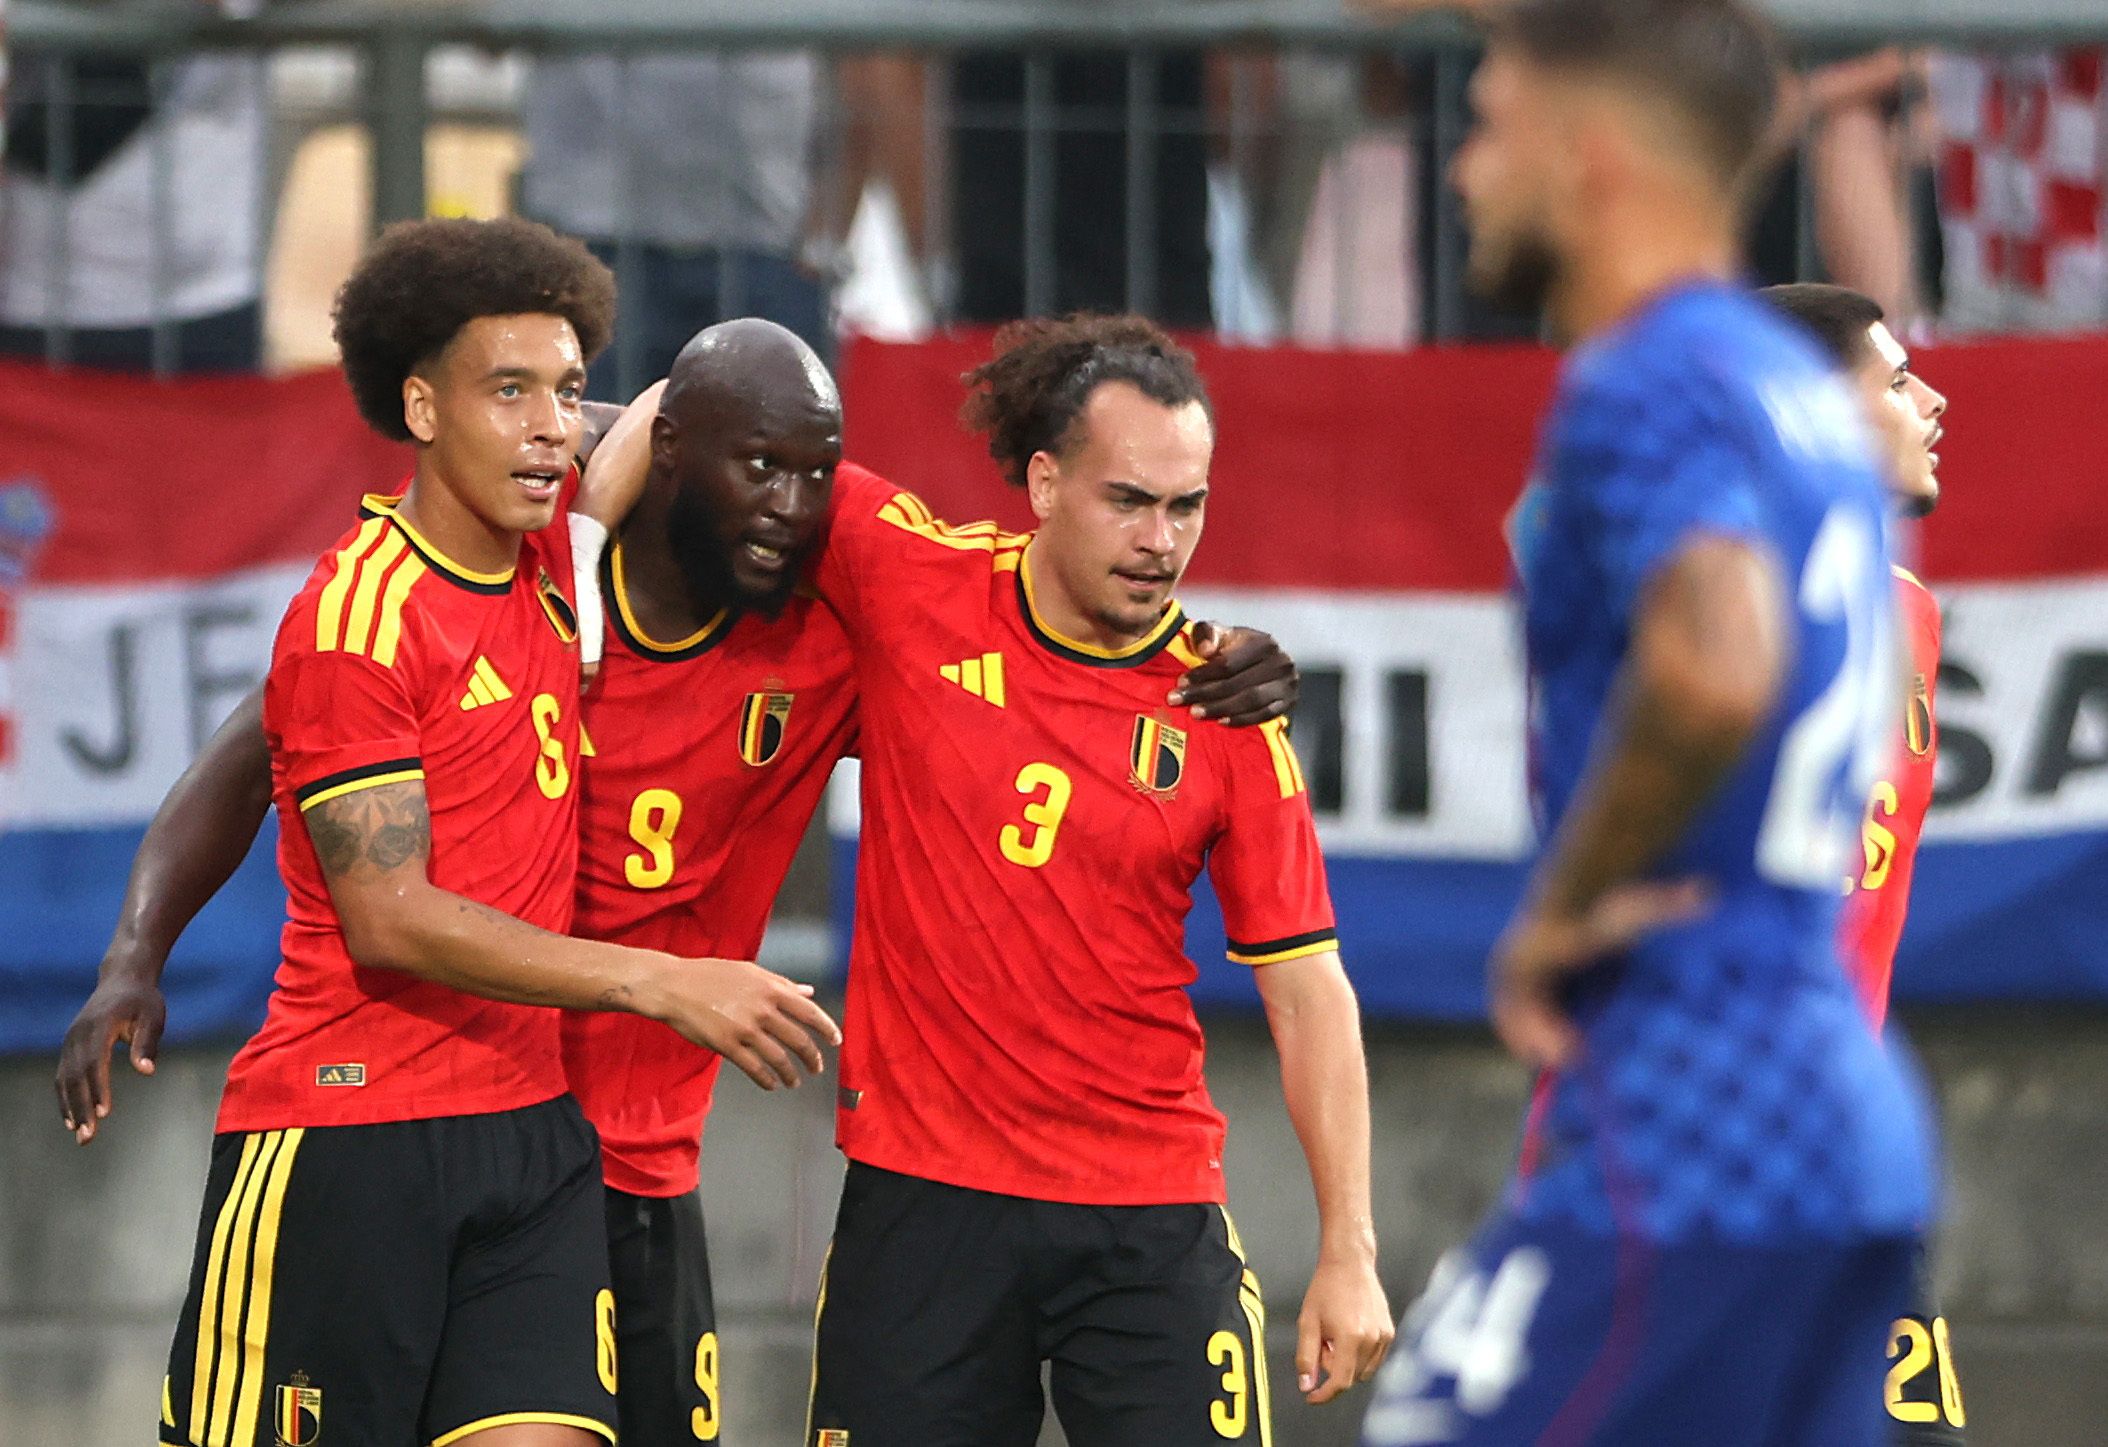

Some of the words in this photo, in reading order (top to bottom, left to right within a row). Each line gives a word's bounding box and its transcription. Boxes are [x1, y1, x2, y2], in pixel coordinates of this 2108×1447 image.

[531, 693, 570, 800] 6
[624, 788, 683, 889] 9
[999, 761, 1071, 868] 3
[691, 1331, 720, 1441] 9
[1207, 1329, 1246, 1438] 3
